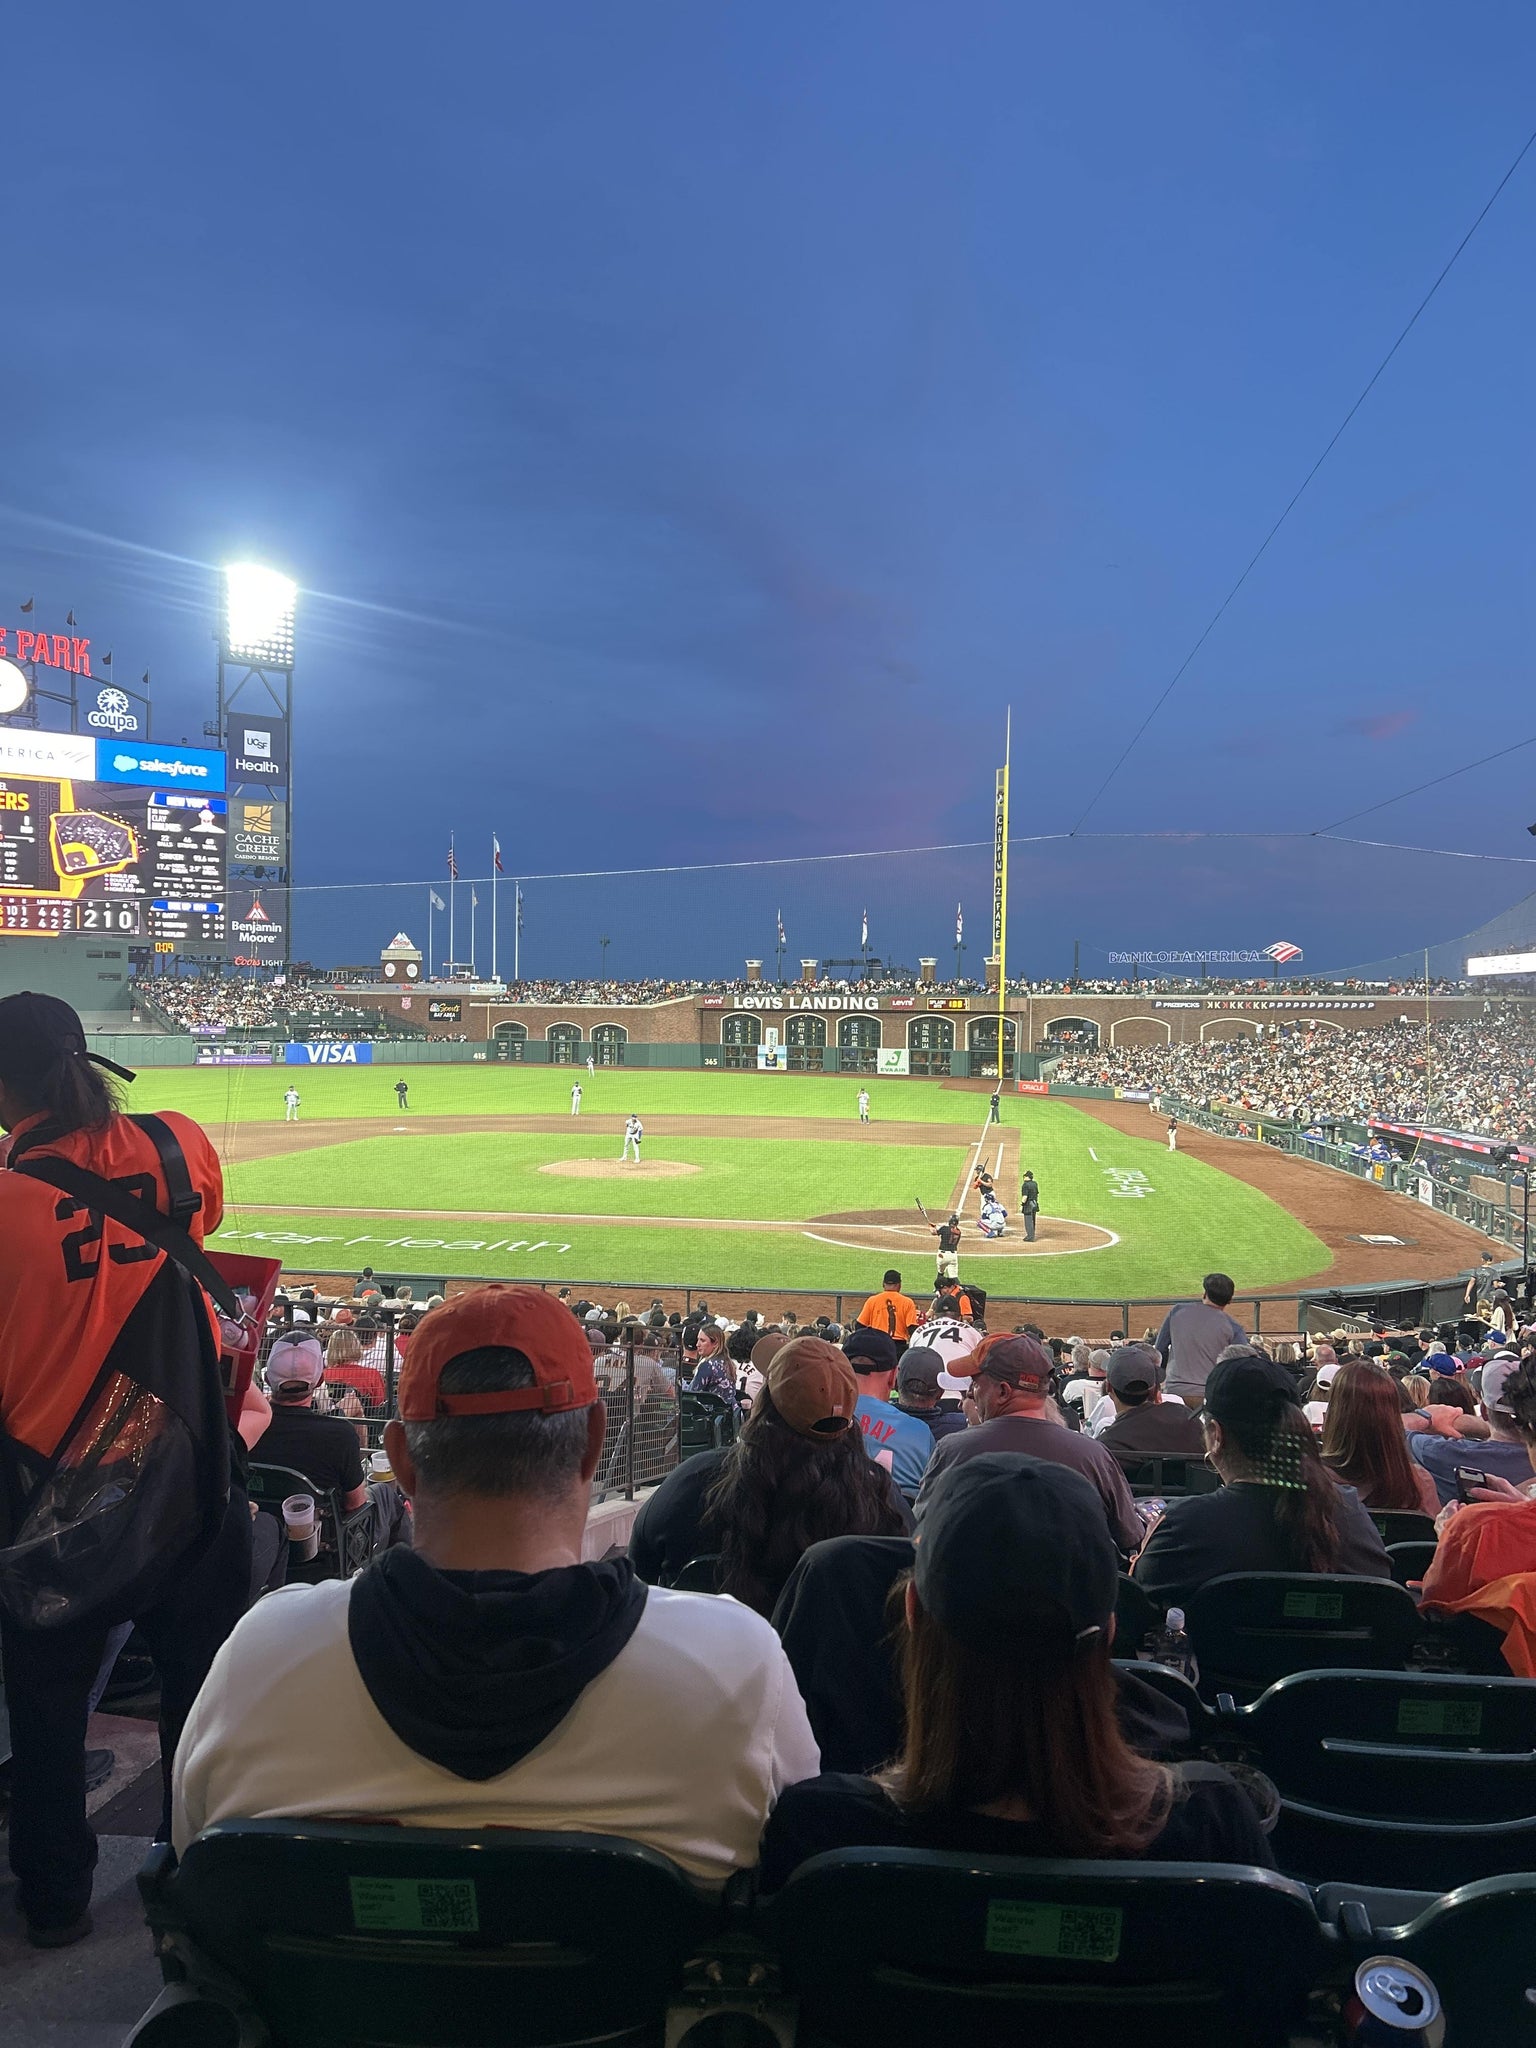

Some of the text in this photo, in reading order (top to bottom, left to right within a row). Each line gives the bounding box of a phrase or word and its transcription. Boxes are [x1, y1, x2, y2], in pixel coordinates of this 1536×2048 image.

[16, 630, 92, 677] PARK
[89, 712, 137, 731] coupa
[246, 738, 268, 750] UCSF
[0, 746, 55, 760] ERICA
[139, 758, 208, 777] salesforce
[235, 758, 279, 773] Health
[234, 833, 280, 845] CACHE
[236, 843, 278, 855] CREEK
[6, 905, 18, 916] 10
[22, 906, 27, 916] 1
[63, 908, 71, 917] 2
[7, 917, 16, 927] 2
[20, 918, 29, 928] 2
[50, 919, 59, 929] 2
[62, 919, 71, 929] 2
[83, 909, 132, 929] 2 1 0
[231, 921, 282, 934] Benjamin
[239, 932, 276, 943] Moore
[155, 942, 174, 953] 0:09
[234, 955, 261, 966] Coors
[1109, 950, 1260, 963] BANK OF AMERICA
[439, 1003, 461, 1012] Sports
[789, 996, 879, 1010] LANDING
[302, 1044, 357, 1063] VISA
[473, 1052, 487, 1060] 415
[704, 1058, 718, 1066] 365
[981, 1067, 998, 1076] 309
[218, 1230, 572, 1254] UCSF Health
[922, 1327, 963, 1348] 74
[738, 1361, 756, 1375] LEE
